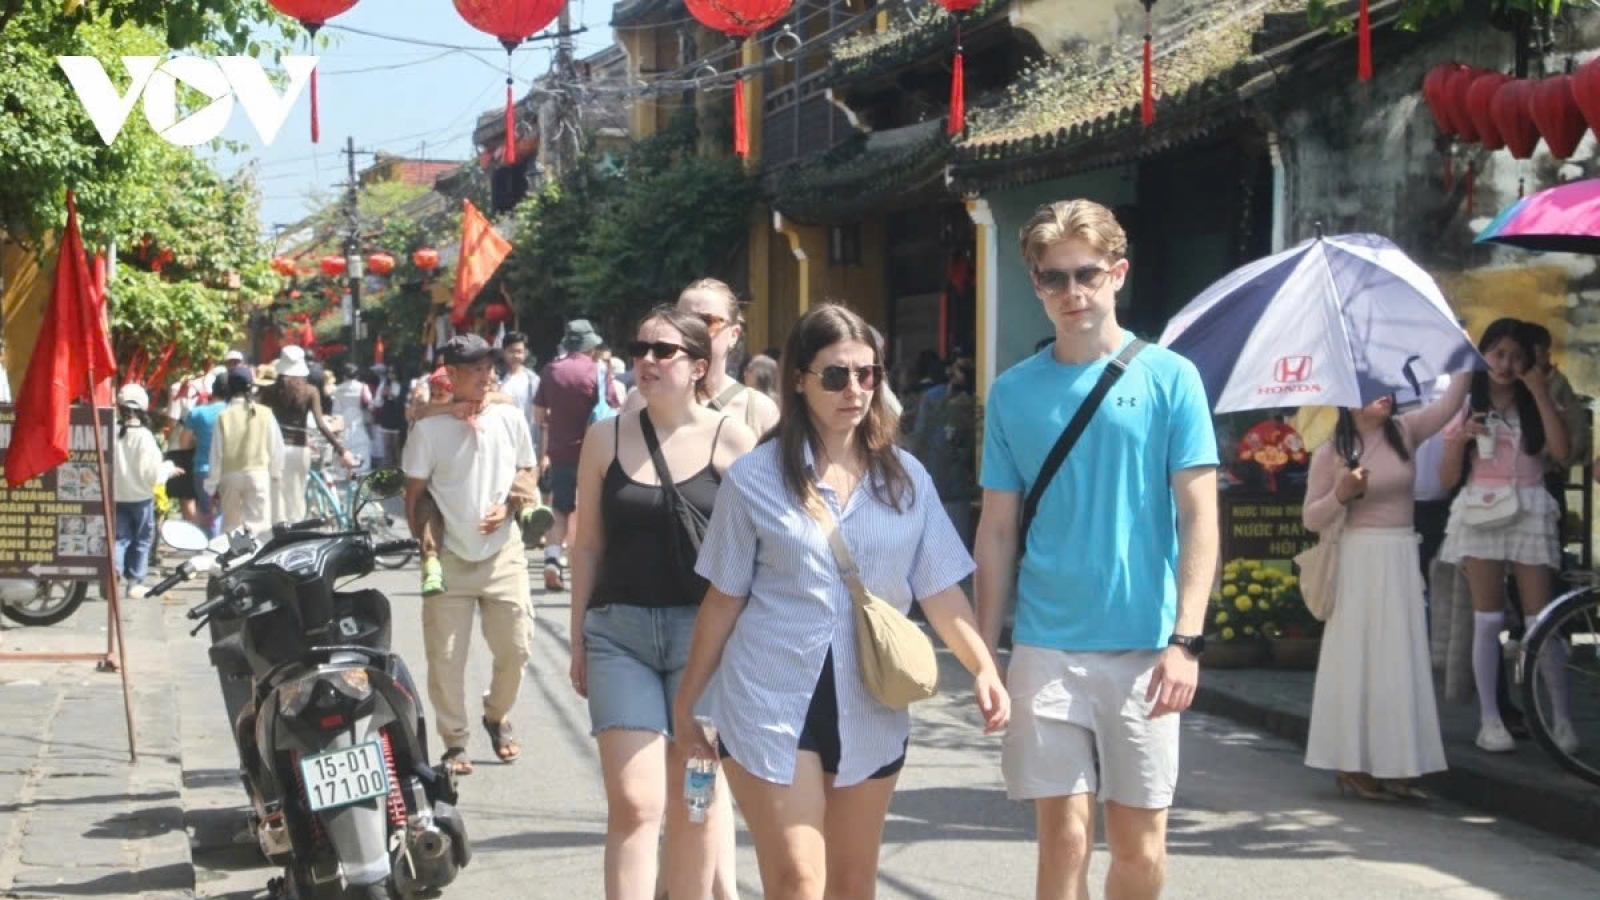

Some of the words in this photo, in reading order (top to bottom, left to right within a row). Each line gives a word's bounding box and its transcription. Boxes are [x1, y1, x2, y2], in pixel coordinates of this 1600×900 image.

[1258, 384, 1322, 395] HONDA
[315, 747, 370, 780] 15-D1
[313, 770, 384, 807] 171.00
